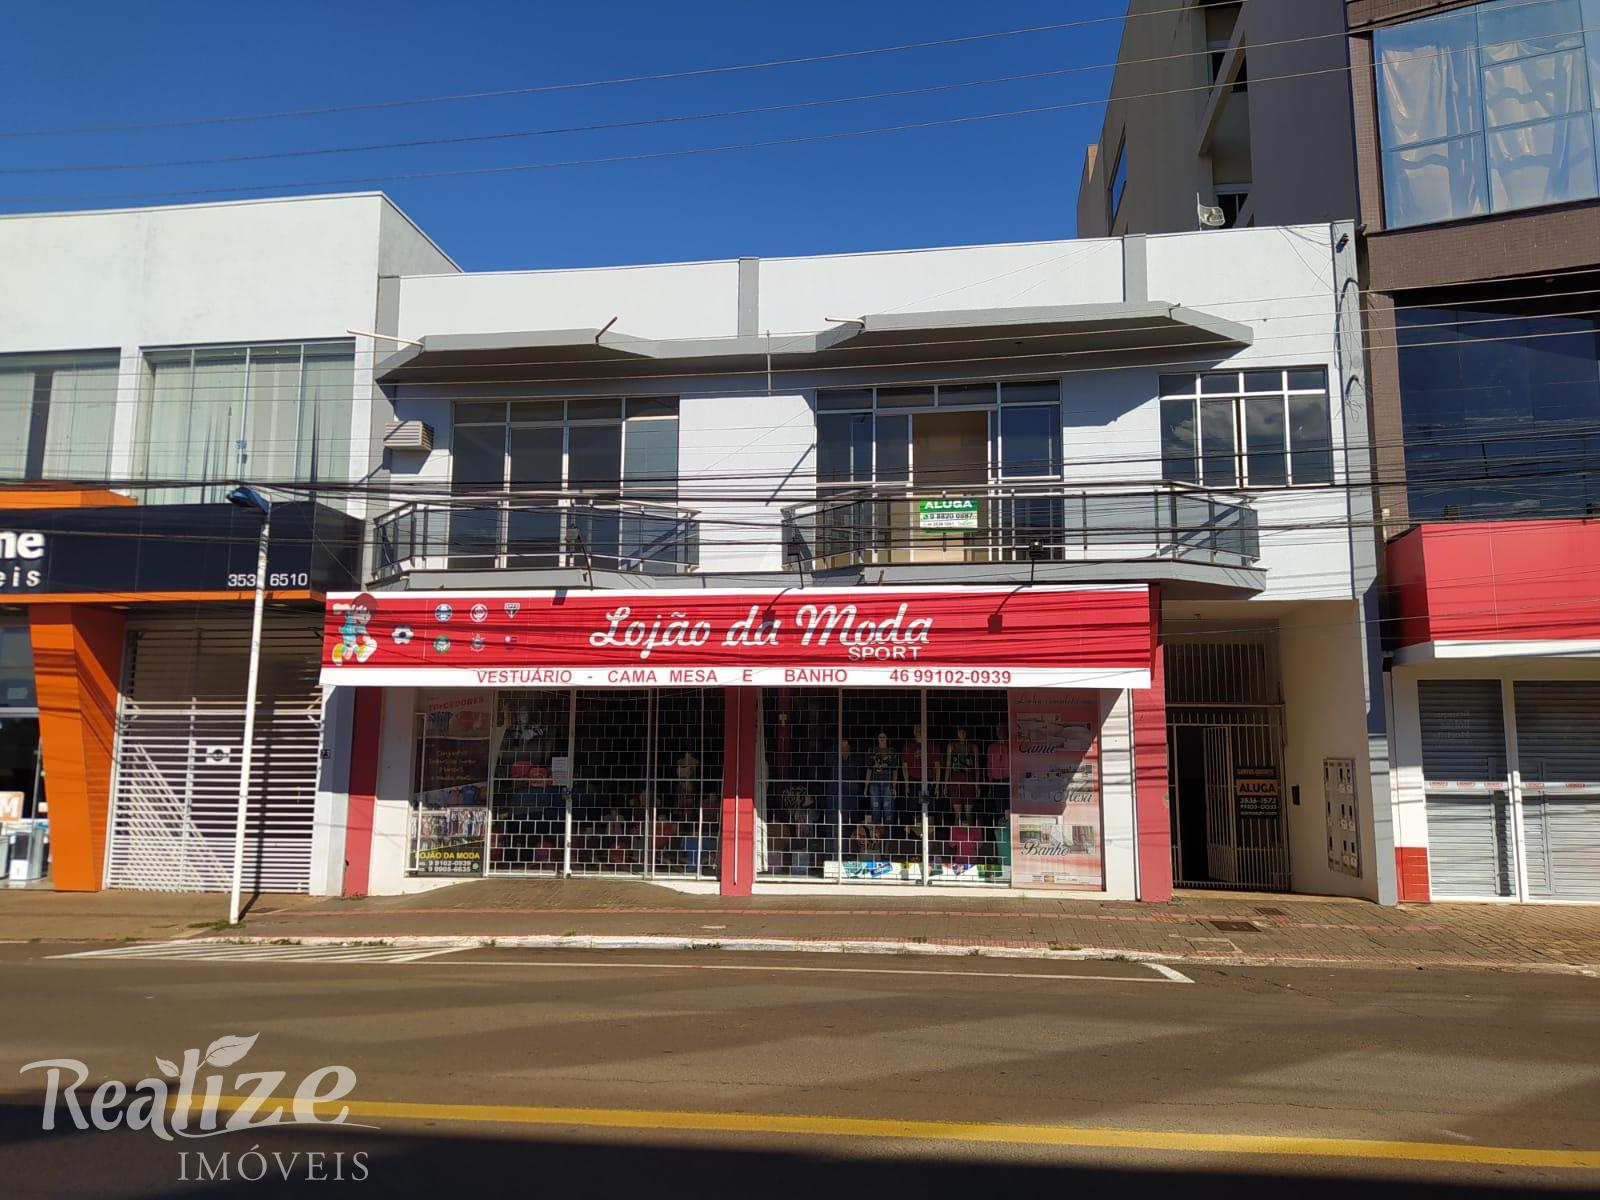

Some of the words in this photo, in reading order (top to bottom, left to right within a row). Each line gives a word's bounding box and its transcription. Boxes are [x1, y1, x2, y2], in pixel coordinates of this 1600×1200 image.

[924, 500, 972, 509] ALUGA
[228, 573, 258, 587] 353
[269, 572, 308, 587] 6510
[589, 606, 711, 660] Lojão
[720, 605, 782, 646] da
[796, 603, 933, 646] Moda
[848, 646, 923, 661] SPORT
[477, 667, 572, 684] VESTUÁRIO
[607, 669, 657, 684] CAMA
[668, 669, 718, 683] MESA
[742, 669, 753, 683] E
[784, 668, 848, 683] BANHO
[889, 669, 910, 683] 46
[913, 669, 1012, 684] 99102-0939
[1240, 783, 1276, 793] ALUGA
[1053, 788, 1093, 804] Mesa
[415, 851, 441, 859] OJÃO
[443, 851, 454, 859] DA
[1021, 839, 1071, 857] Banho
